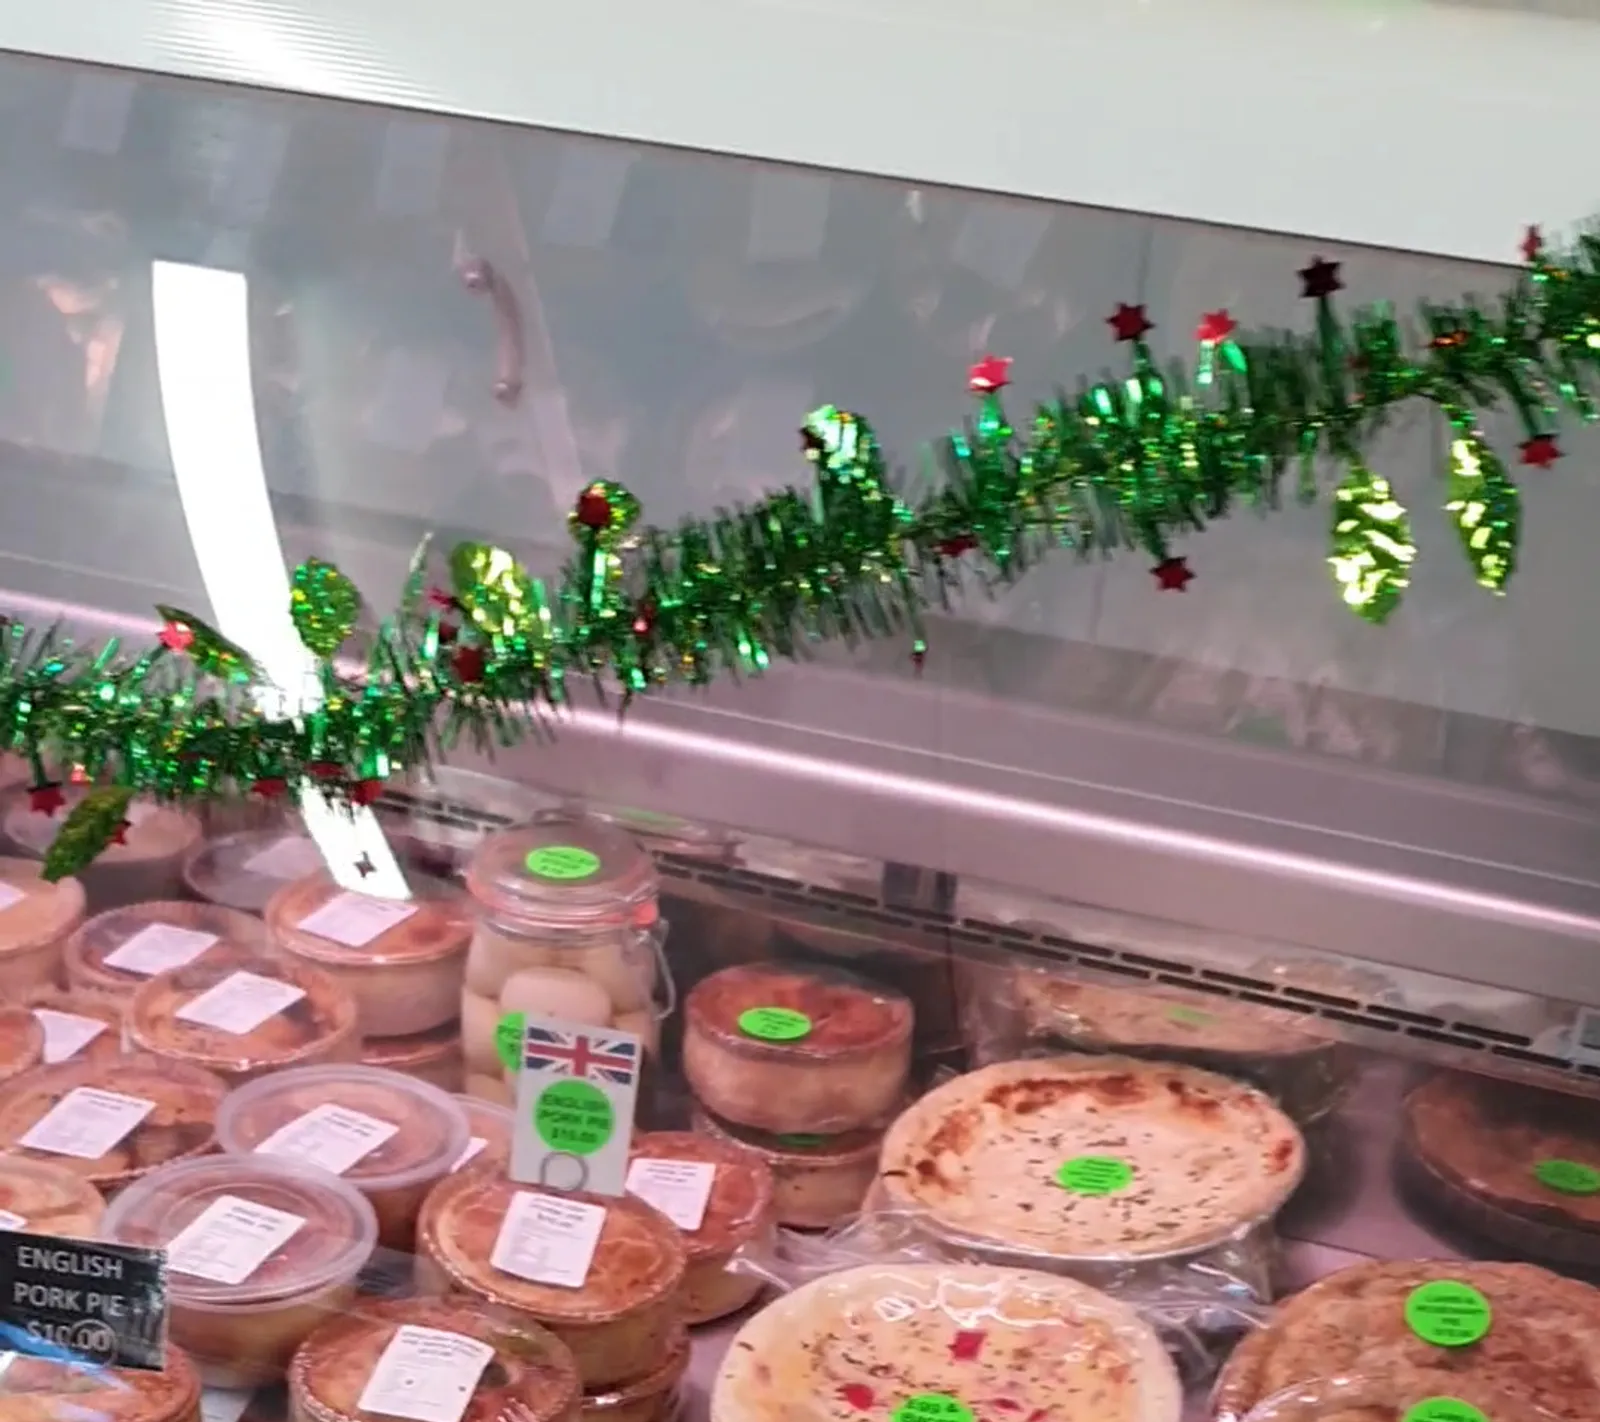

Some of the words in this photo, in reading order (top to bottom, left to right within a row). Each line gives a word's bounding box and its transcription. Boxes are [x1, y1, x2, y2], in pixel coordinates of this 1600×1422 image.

[541, 1094, 610, 1112] ENGLISH
[537, 1109, 583, 1125] PORK
[17, 1245, 124, 1280] ENGLISH
[13, 1281, 82, 1312] PORK
[86, 1292, 127, 1318] PIE
[26, 1319, 111, 1352] $10.00
[906, 1399, 940, 1415] Egg
[945, 1402, 960, 1413] &
